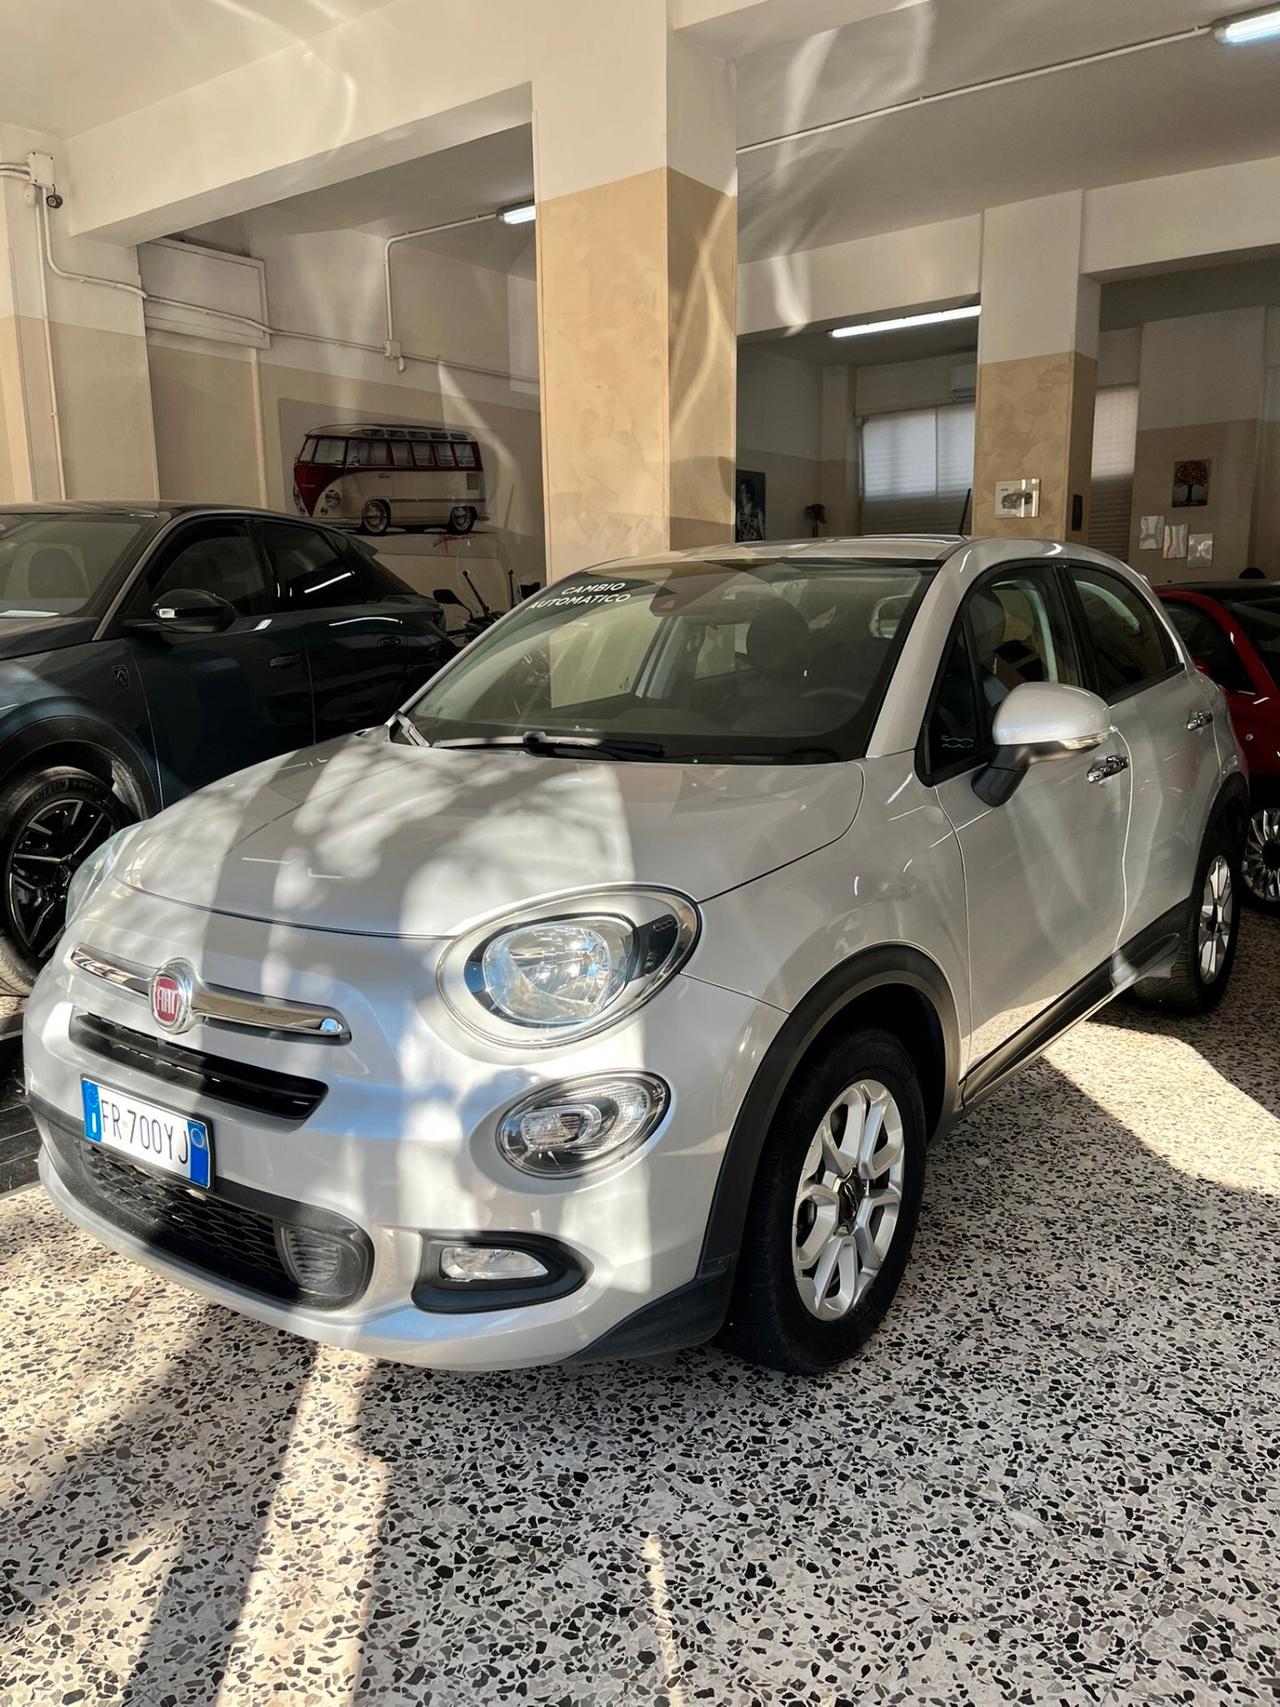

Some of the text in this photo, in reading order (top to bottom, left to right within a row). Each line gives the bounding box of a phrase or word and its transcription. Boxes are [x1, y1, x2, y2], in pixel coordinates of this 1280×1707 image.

[561, 582, 627, 595] CAMBIO
[525, 593, 632, 609] AUTOMATICO
[156, 985, 179, 1015] FIAT
